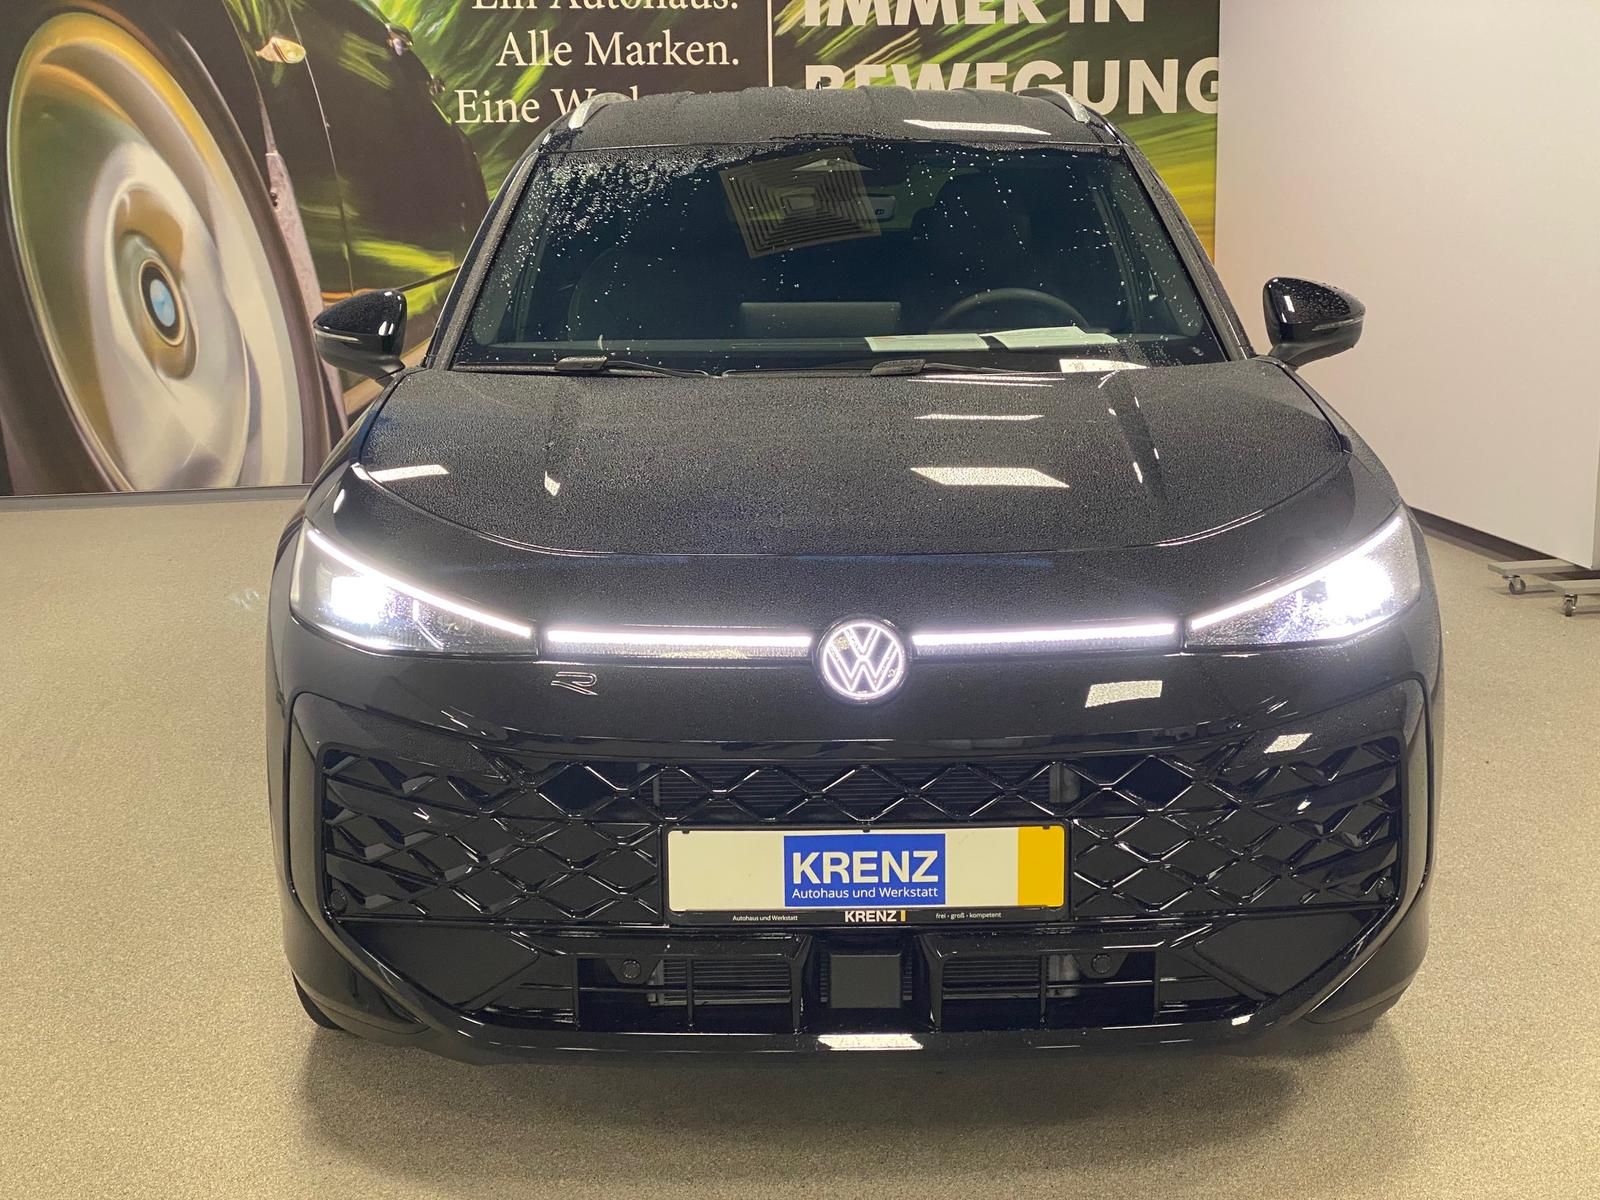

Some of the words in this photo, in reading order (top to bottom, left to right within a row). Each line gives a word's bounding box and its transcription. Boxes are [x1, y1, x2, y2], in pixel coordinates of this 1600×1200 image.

[496, 30, 572, 66] Alle
[584, 30, 739, 66] Marken.
[454, 89, 540, 124] Eine
[792, 850, 939, 885] KRENZ
[792, 888, 850, 899] Autohaus
[852, 887, 876, 898] und
[879, 887, 939, 898] Werkstatt
[732, 914, 759, 922] Autohaus
[844, 910, 897, 923] KRENZ
[935, 911, 947, 919] frei
[950, 911, 965, 920] groß
[969, 911, 1002, 920] kompetent
